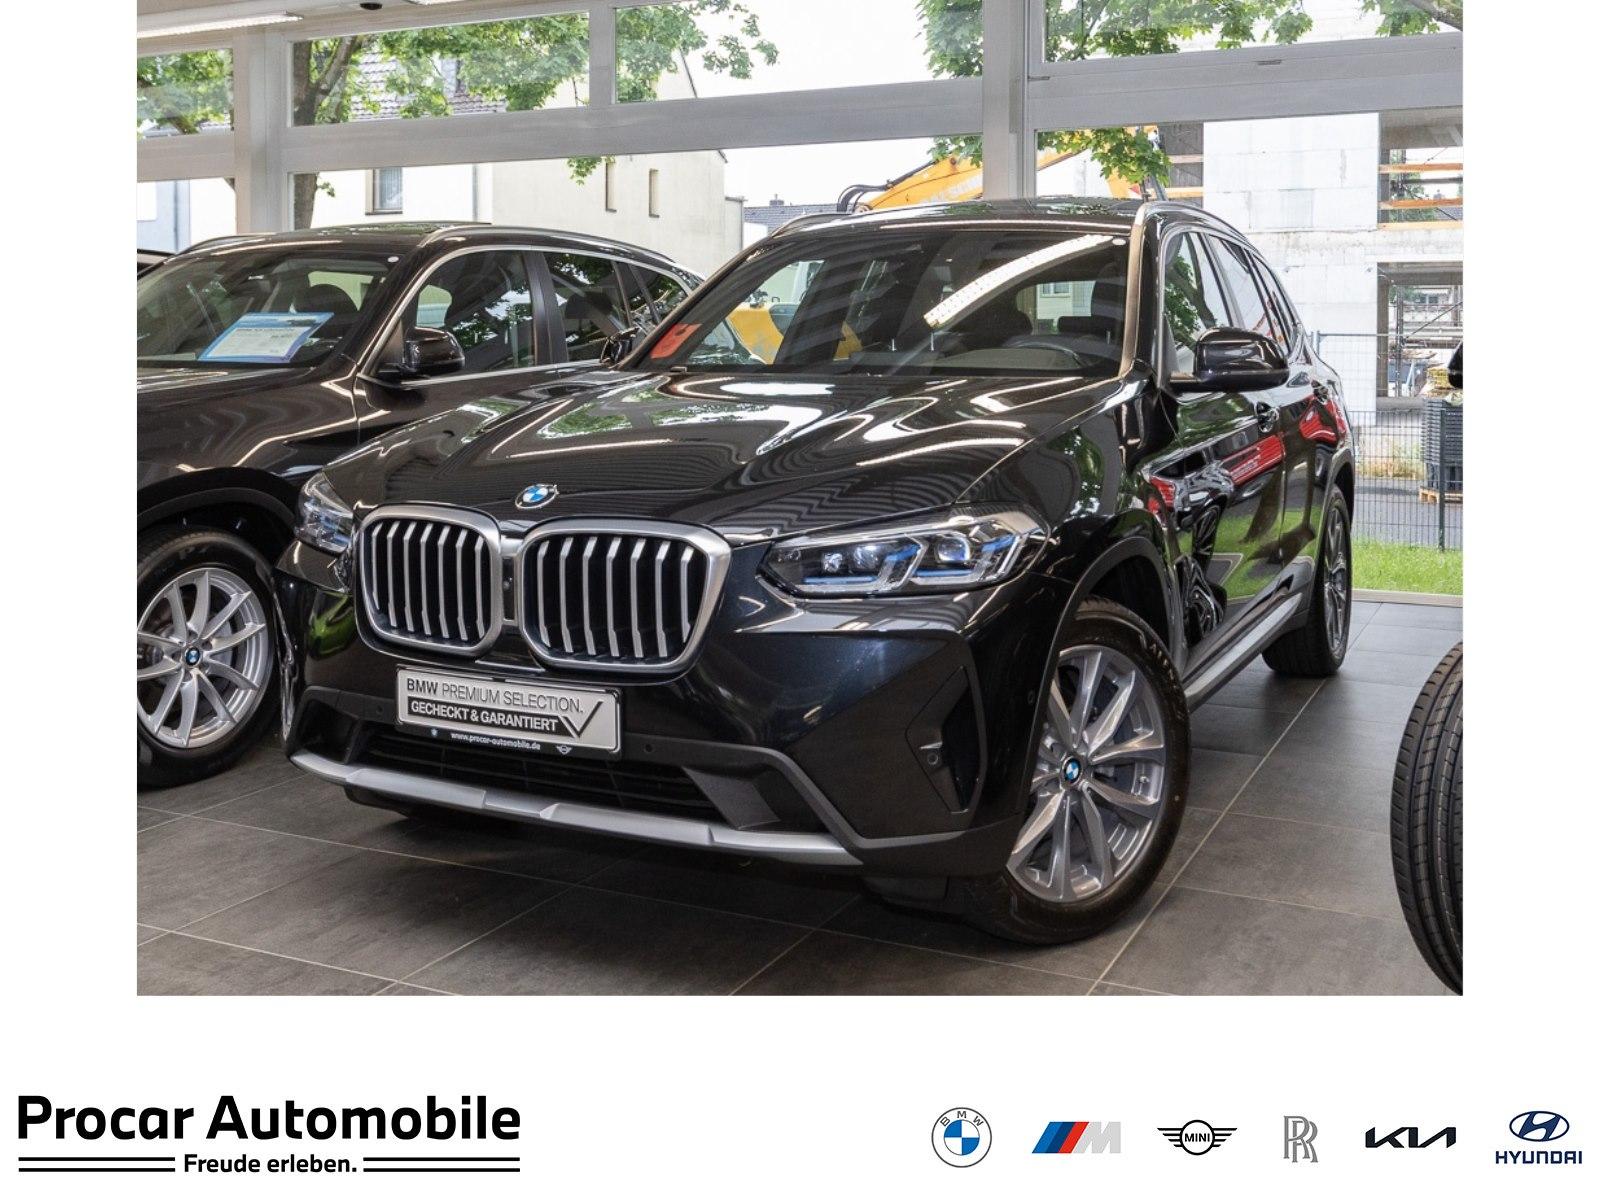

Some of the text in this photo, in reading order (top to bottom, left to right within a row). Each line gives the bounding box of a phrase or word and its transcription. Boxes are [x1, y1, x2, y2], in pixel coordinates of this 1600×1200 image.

[407, 677, 583, 714] BMW PREMIUM SELECTION.
[411, 700, 559, 732] GECHECKT & GARANTIERT
[450, 732, 541, 751] www.procar-automobile.de
